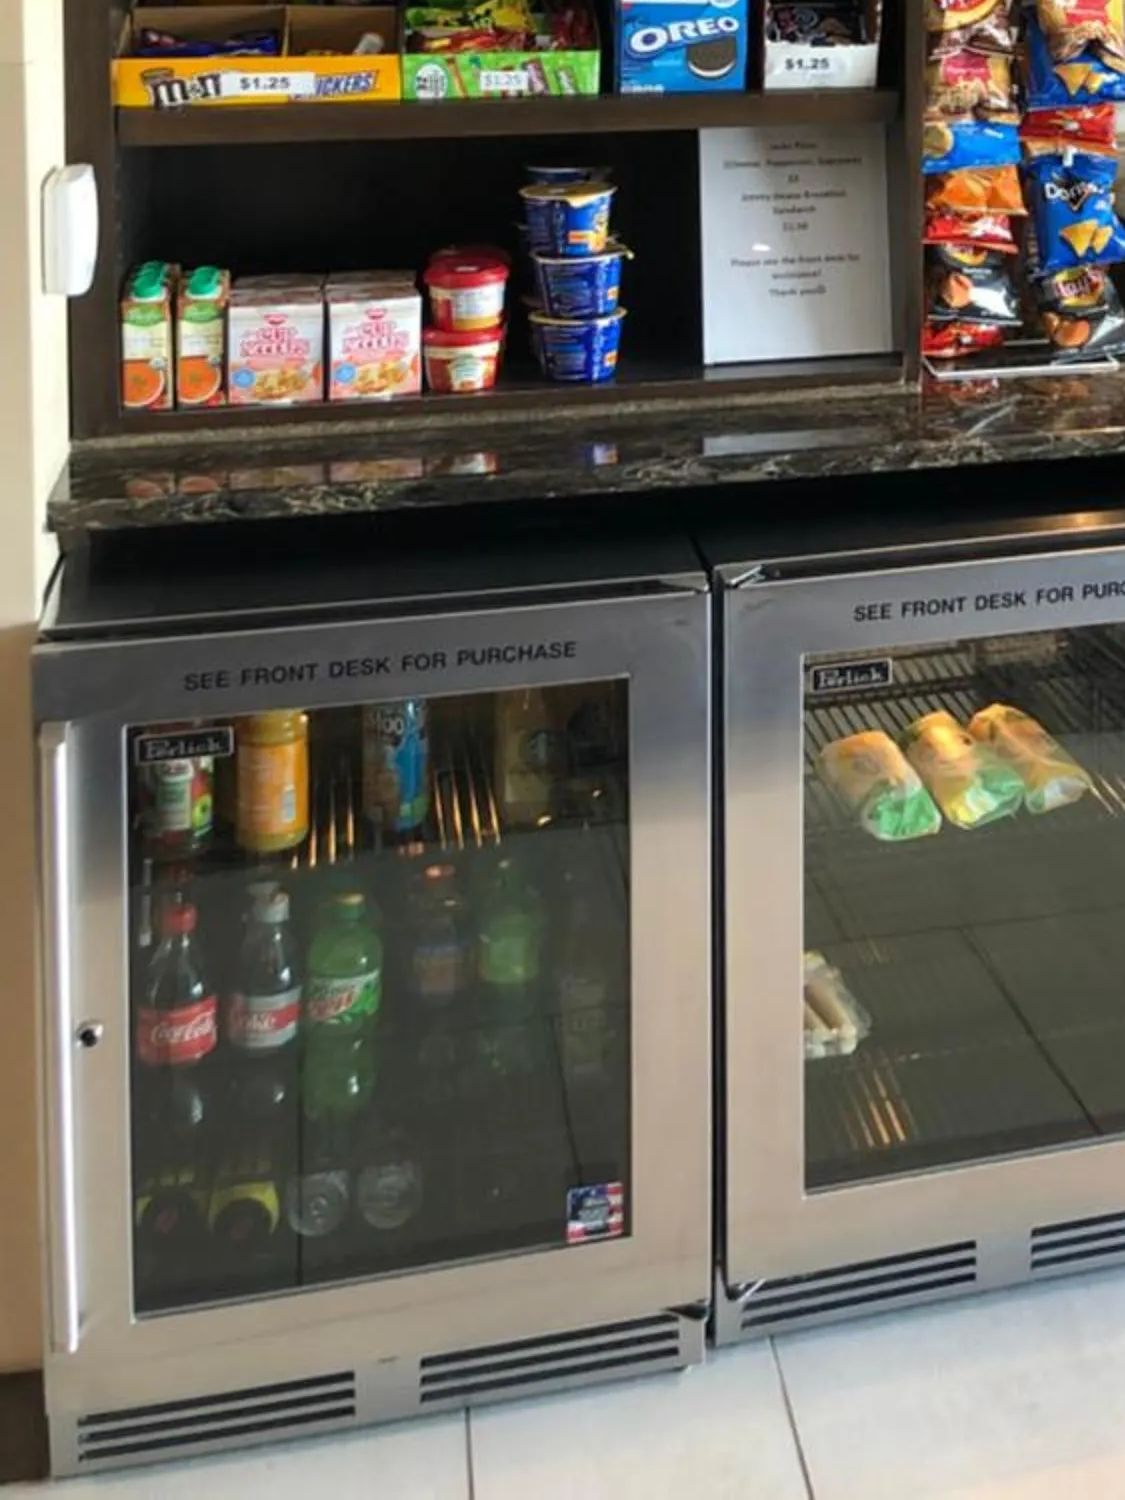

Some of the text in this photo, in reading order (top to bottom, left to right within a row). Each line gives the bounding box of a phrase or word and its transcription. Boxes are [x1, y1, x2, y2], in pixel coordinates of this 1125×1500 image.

[630, 16, 740, 53] OREO
[784, 57, 830, 71] $1.25
[238, 76, 291, 90] $1.25
[314, 72, 378, 97] ICKERS
[483, 73, 523, 87] $1.25
[853, 603, 893, 622] SEE
[900, 596, 967, 619] FRONT
[974, 590, 1027, 612] DESK
[1035, 586, 1075, 604] FOR
[182, 640, 579, 693] SEE FRONT DESK FOR PURCHASE
[815, 663, 885, 690] Perlick
